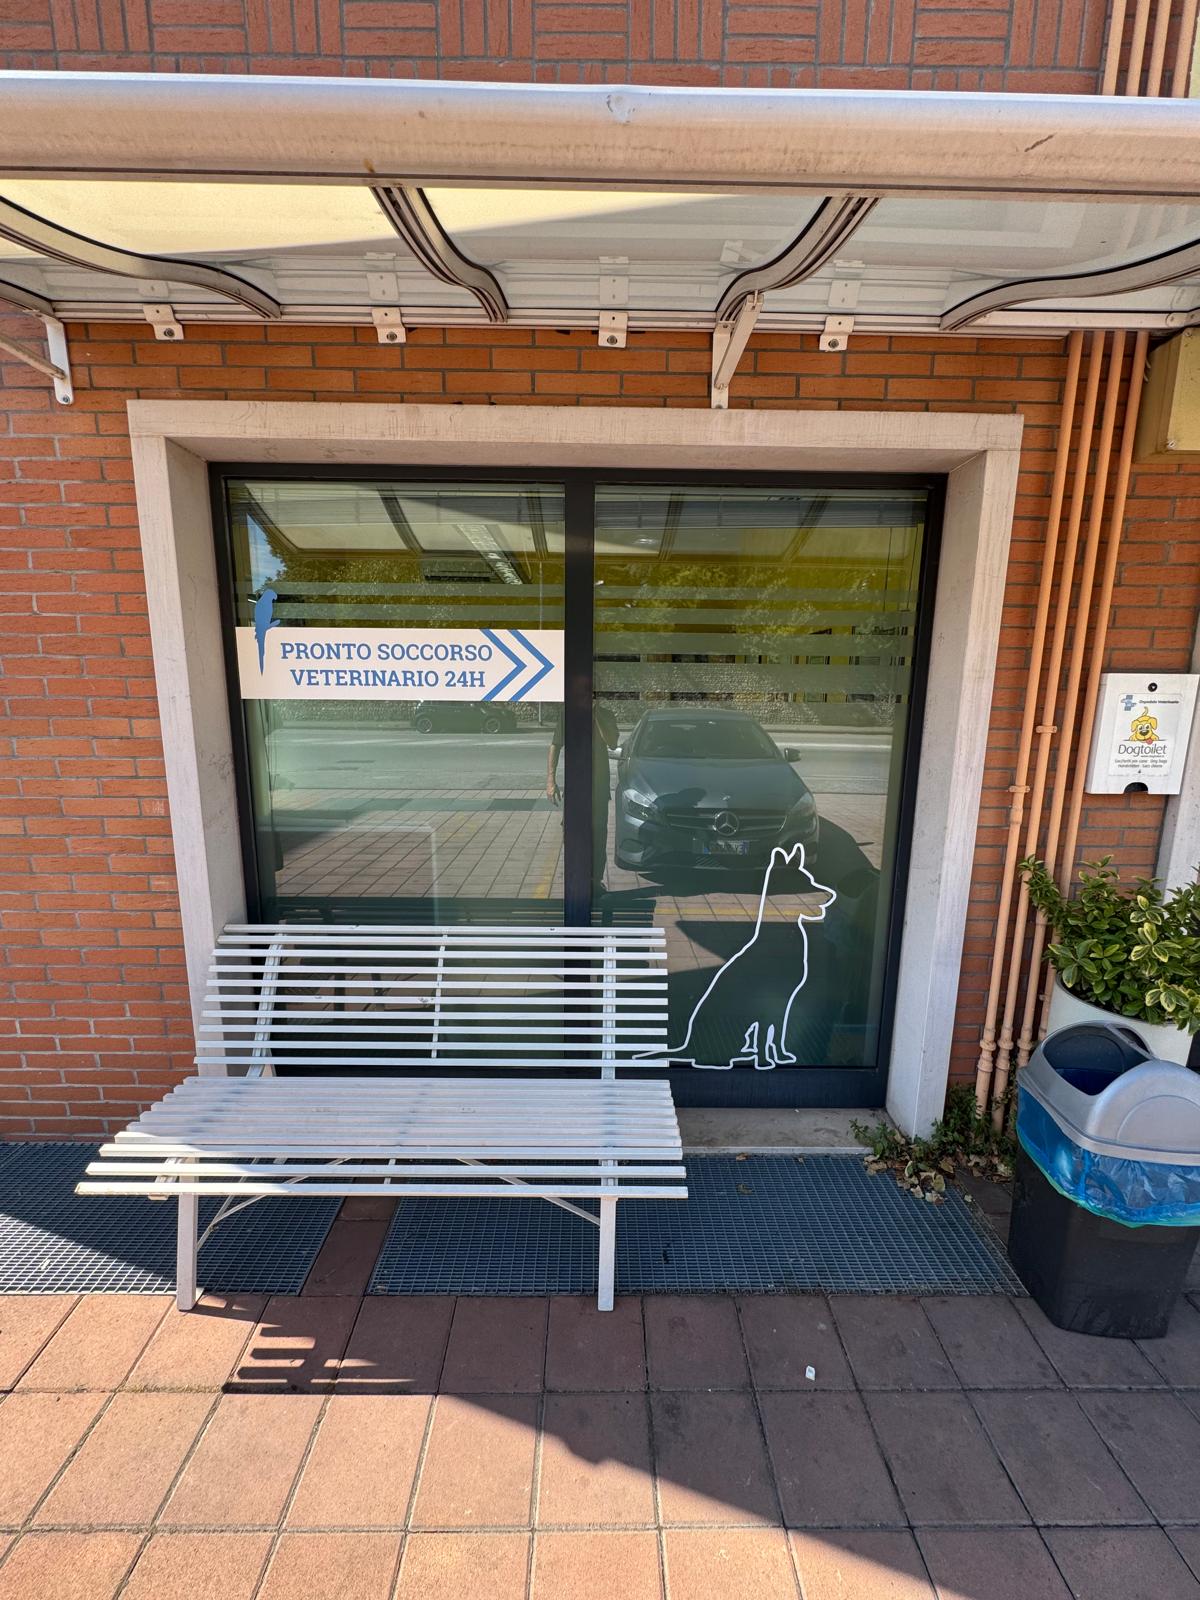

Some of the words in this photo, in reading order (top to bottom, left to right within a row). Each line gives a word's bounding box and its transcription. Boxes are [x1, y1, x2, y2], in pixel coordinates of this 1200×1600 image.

[280, 642, 372, 661] PRONTO
[377, 643, 493, 662] SOCCORSO
[290, 669, 439, 687] VETERINARIO
[445, 670, 486, 688] 24H
[1118, 743, 1168, 757] Dogtoilet
